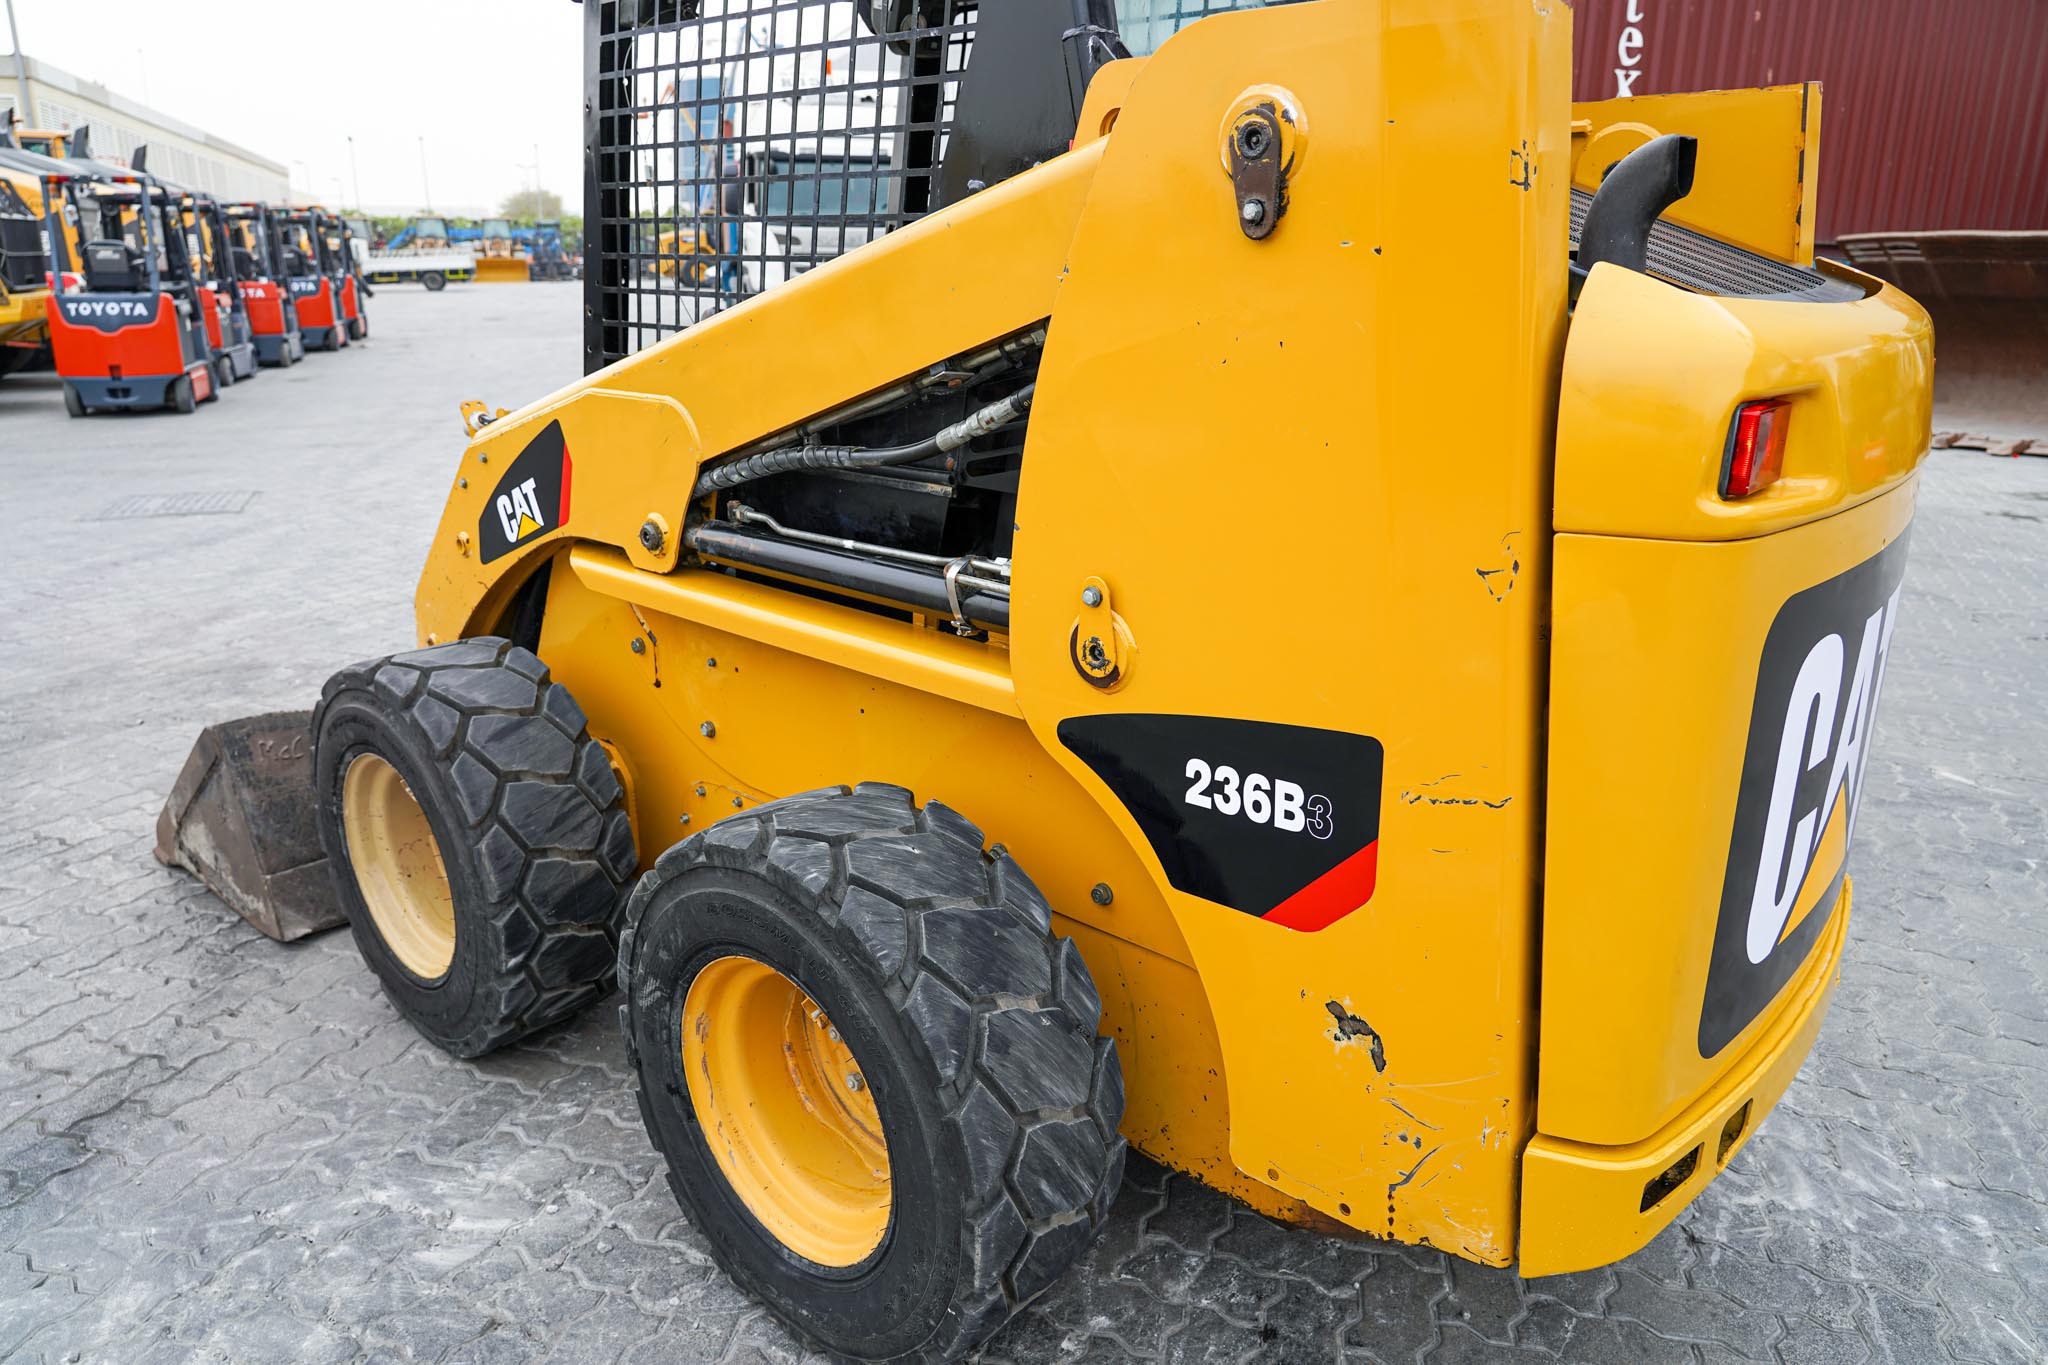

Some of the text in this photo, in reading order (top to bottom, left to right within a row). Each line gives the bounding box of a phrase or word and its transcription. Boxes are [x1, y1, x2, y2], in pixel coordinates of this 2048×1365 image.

[66, 301, 149, 317] TOYOTA
[496, 477, 544, 543] CAT
[1185, 758, 1333, 840] 236B3
[1746, 581, 1900, 965] CAT
